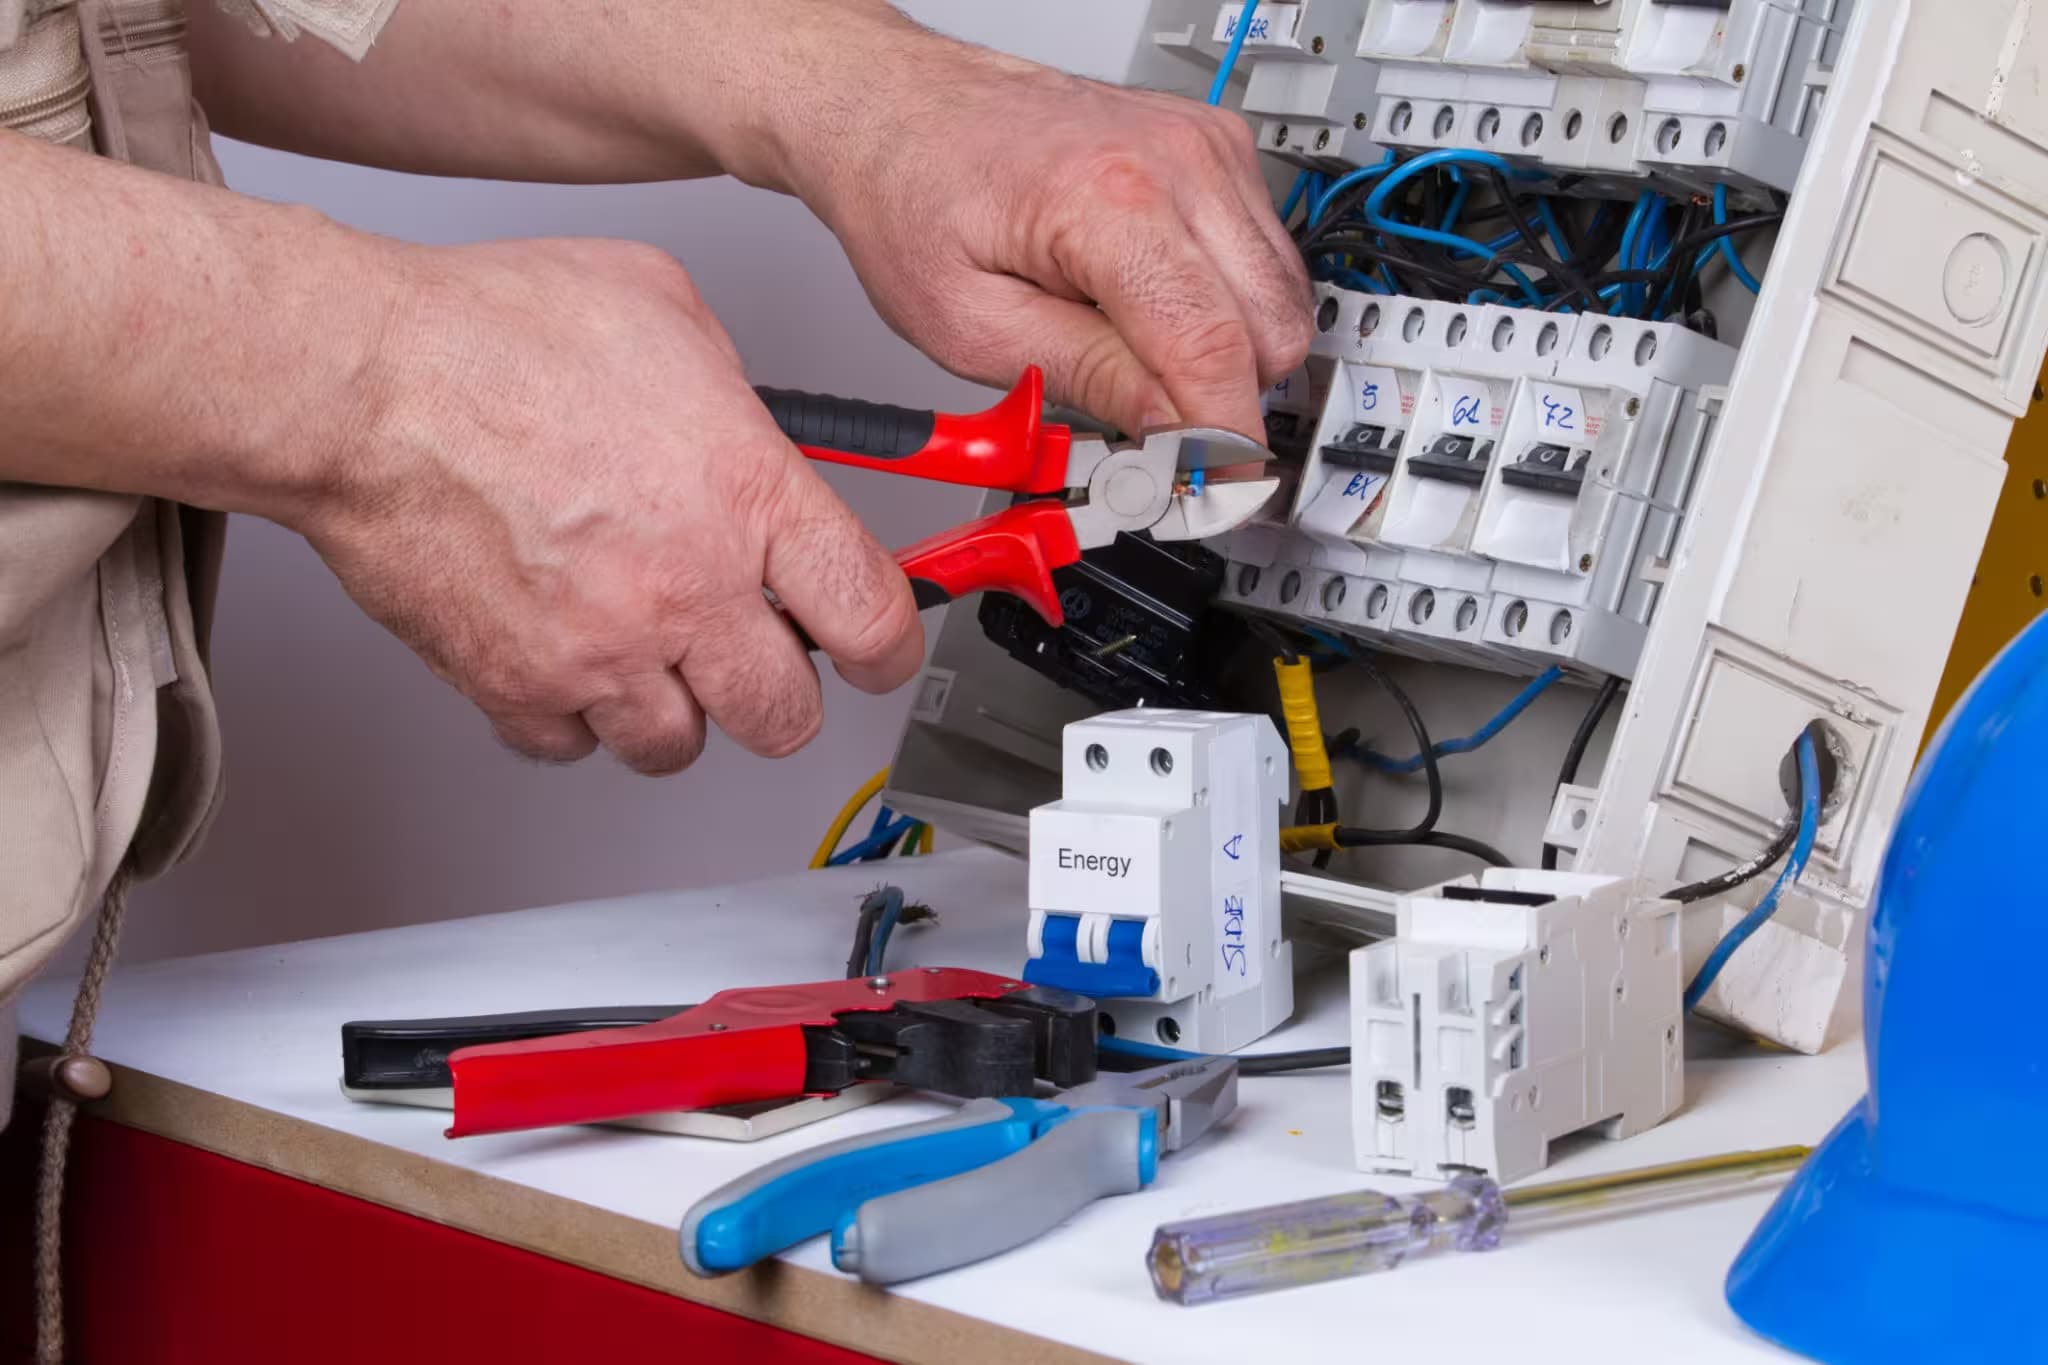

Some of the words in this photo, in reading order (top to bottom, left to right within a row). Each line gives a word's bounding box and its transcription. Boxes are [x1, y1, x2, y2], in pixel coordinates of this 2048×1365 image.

[1362, 380, 1379, 411] 5
[1223, 833, 1243, 860] A
[1058, 847, 1132, 878] Energy
